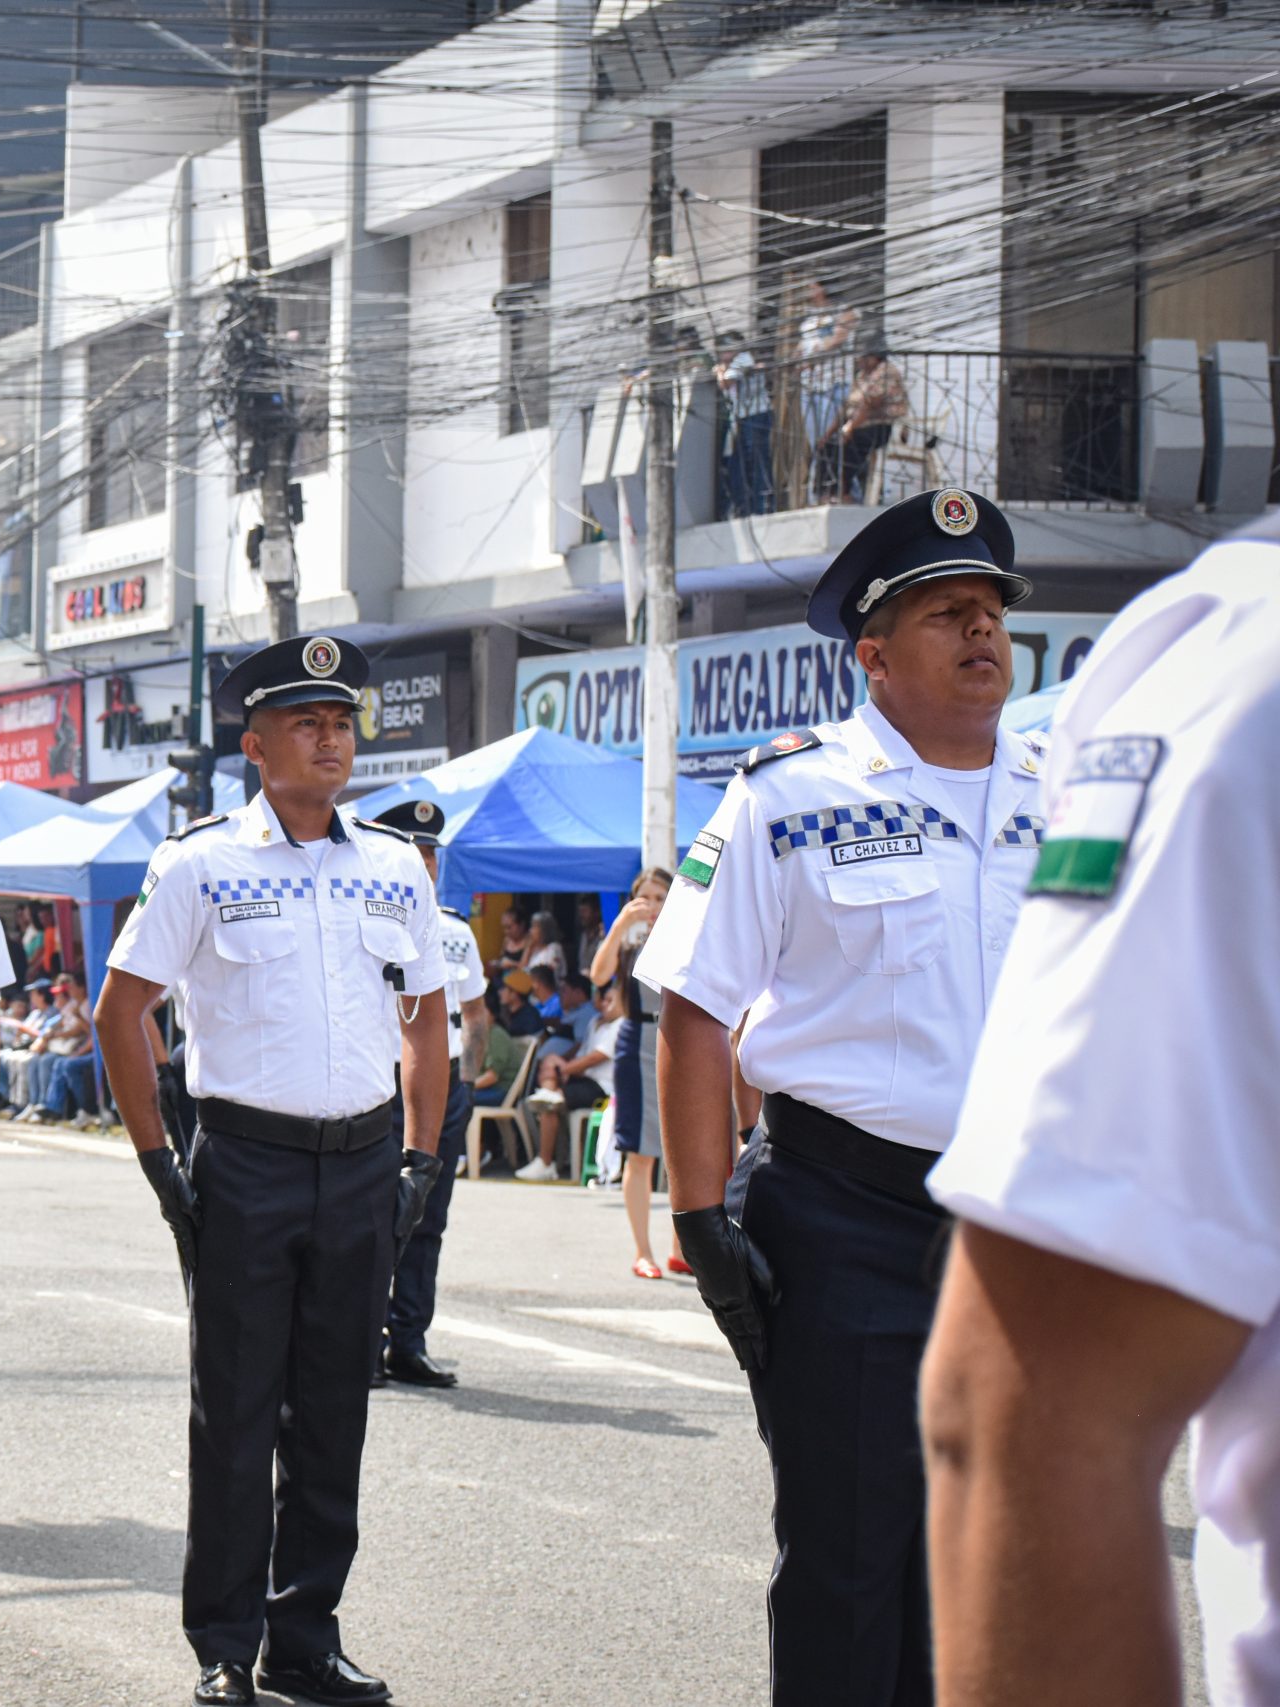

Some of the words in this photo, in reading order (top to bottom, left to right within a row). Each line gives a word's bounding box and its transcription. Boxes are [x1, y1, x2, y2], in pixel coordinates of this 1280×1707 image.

[382, 674, 441, 702] GOLDEN
[575, 667, 680, 744] OPTI
[690, 637, 856, 737] MEGALENS
[382, 703, 424, 728] BEAR
[10, 741, 20, 760] AL
[21, 738, 39, 758] POR
[13, 760, 41, 781] MENOR
[839, 848, 849, 860] F.
[854, 841, 899, 857] CHAVEZ
[905, 839, 916, 851] R.
[369, 903, 405, 921] TRANSITO
